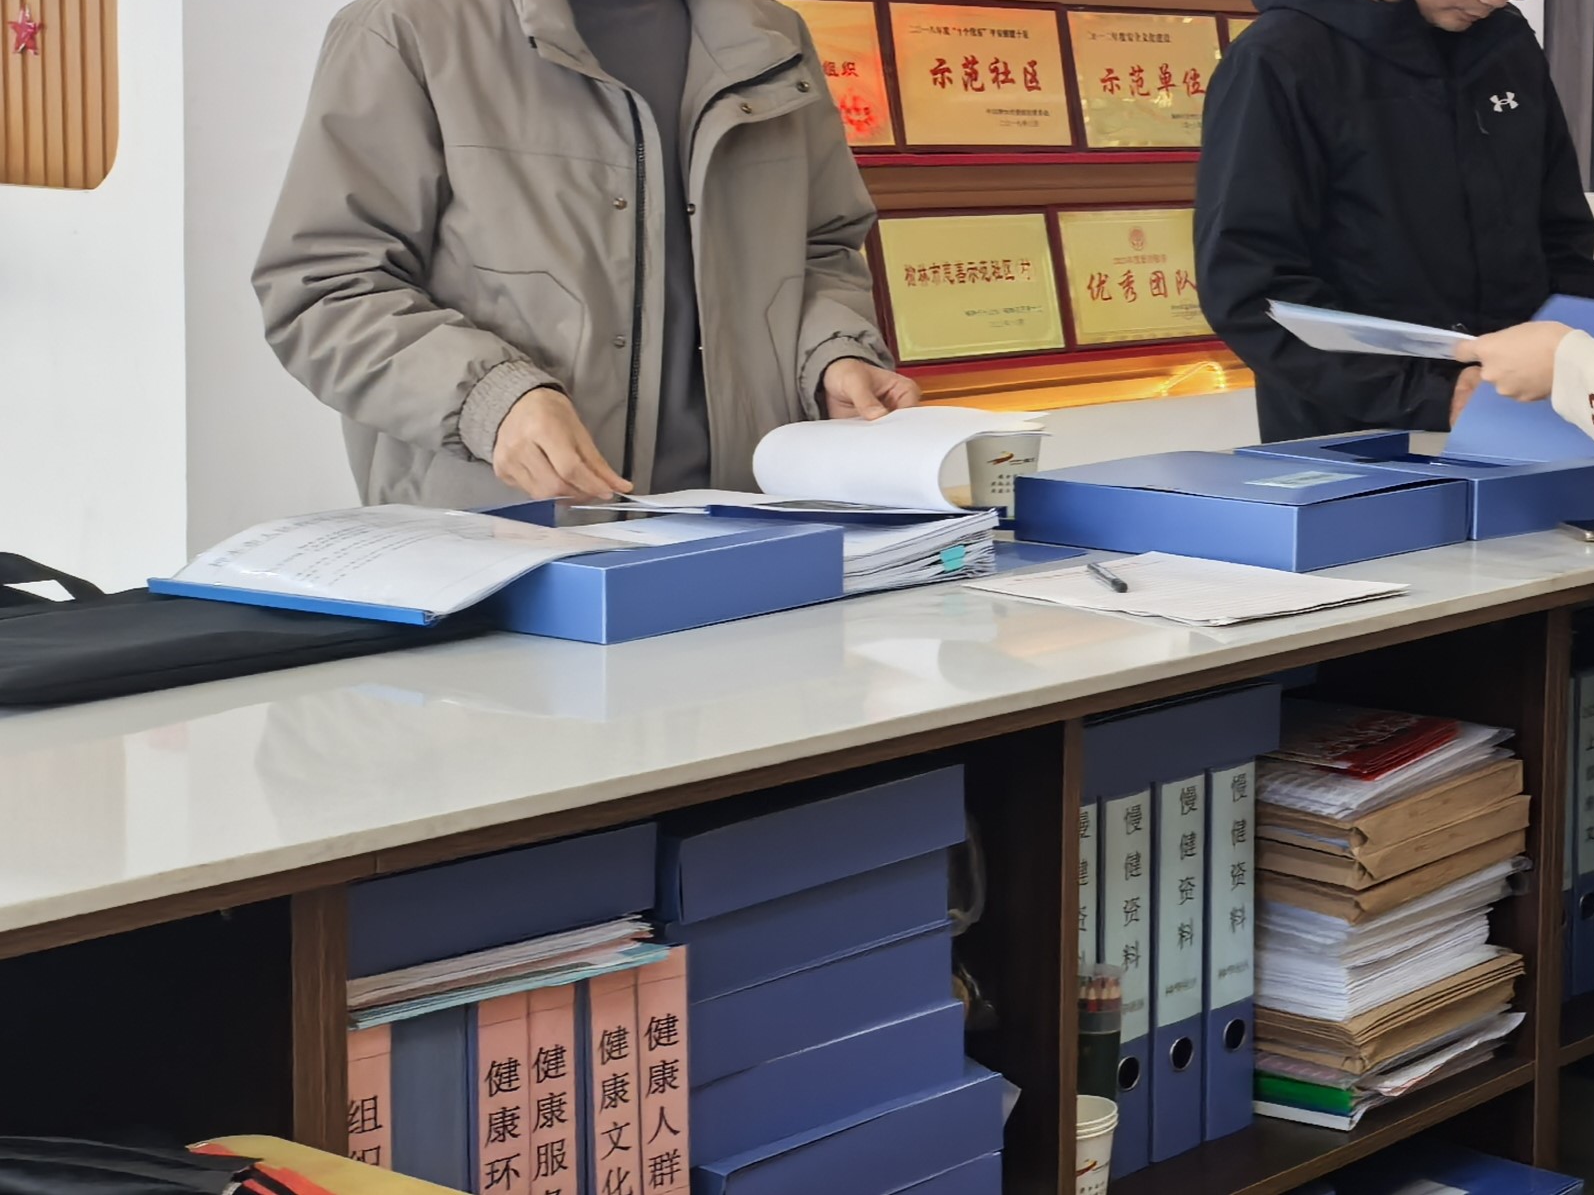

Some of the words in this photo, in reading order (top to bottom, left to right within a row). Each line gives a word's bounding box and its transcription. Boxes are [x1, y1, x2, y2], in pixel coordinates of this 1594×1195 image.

[929, 54, 1042, 92] 示范社区
[1099, 62, 1207, 98] 示范单位
[1087, 269, 1198, 303] 优秀团队
[484, 1057, 522, 1192] 健康环
[531, 1044, 569, 1195] 健康服
[598, 1024, 633, 1195] 健康文化
[644, 1012, 683, 1190] 健康人群
